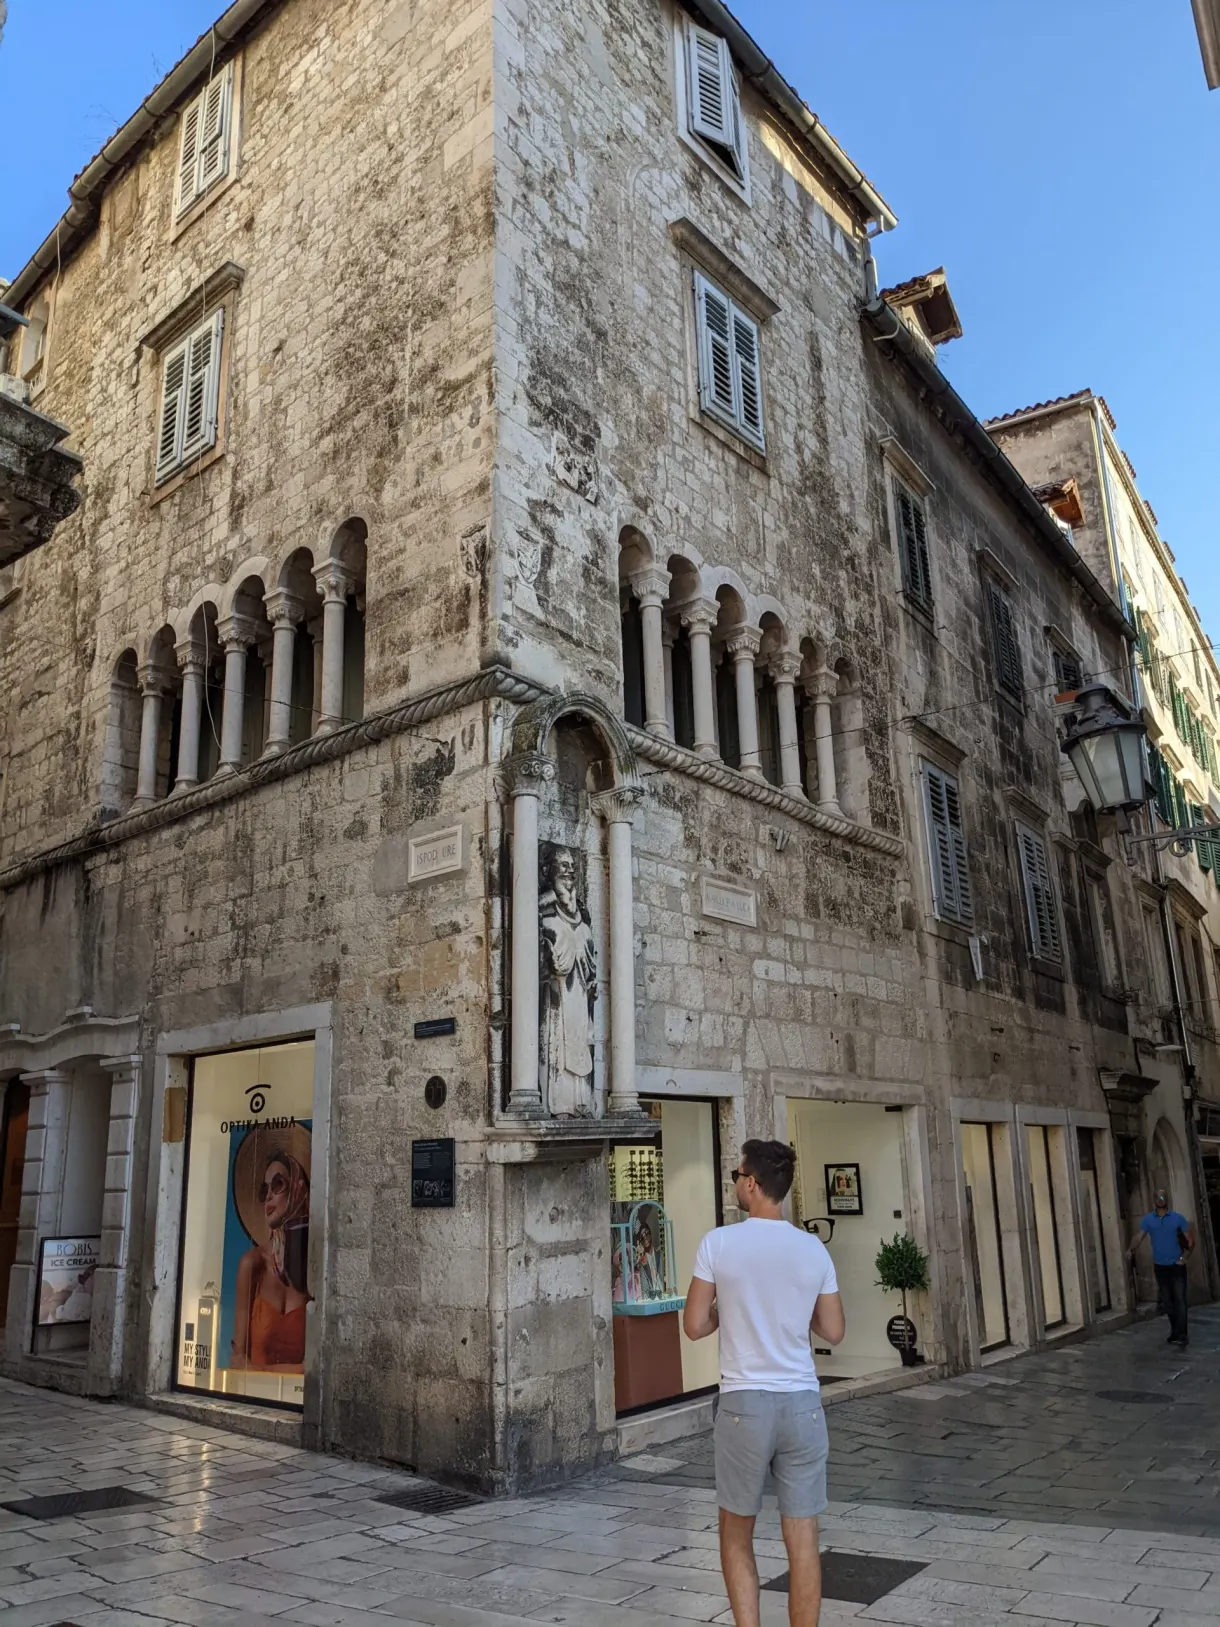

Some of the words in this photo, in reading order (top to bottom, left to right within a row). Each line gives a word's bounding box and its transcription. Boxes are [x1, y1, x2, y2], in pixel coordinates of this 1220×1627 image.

[416, 849, 438, 865] ISPOD
[442, 843, 456, 858] URE
[220, 1119, 260, 1134] OPTIKA
[263, 1115, 296, 1131] ANDA
[56, 1243, 93, 1257] BOBIS
[51, 1259, 65, 1267] ICE
[66, 1258, 97, 1267] CREAM
[659, 1301, 684, 1312] GUCCI
[184, 1342, 194, 1355] MY
[183, 1355, 194, 1368] MY
